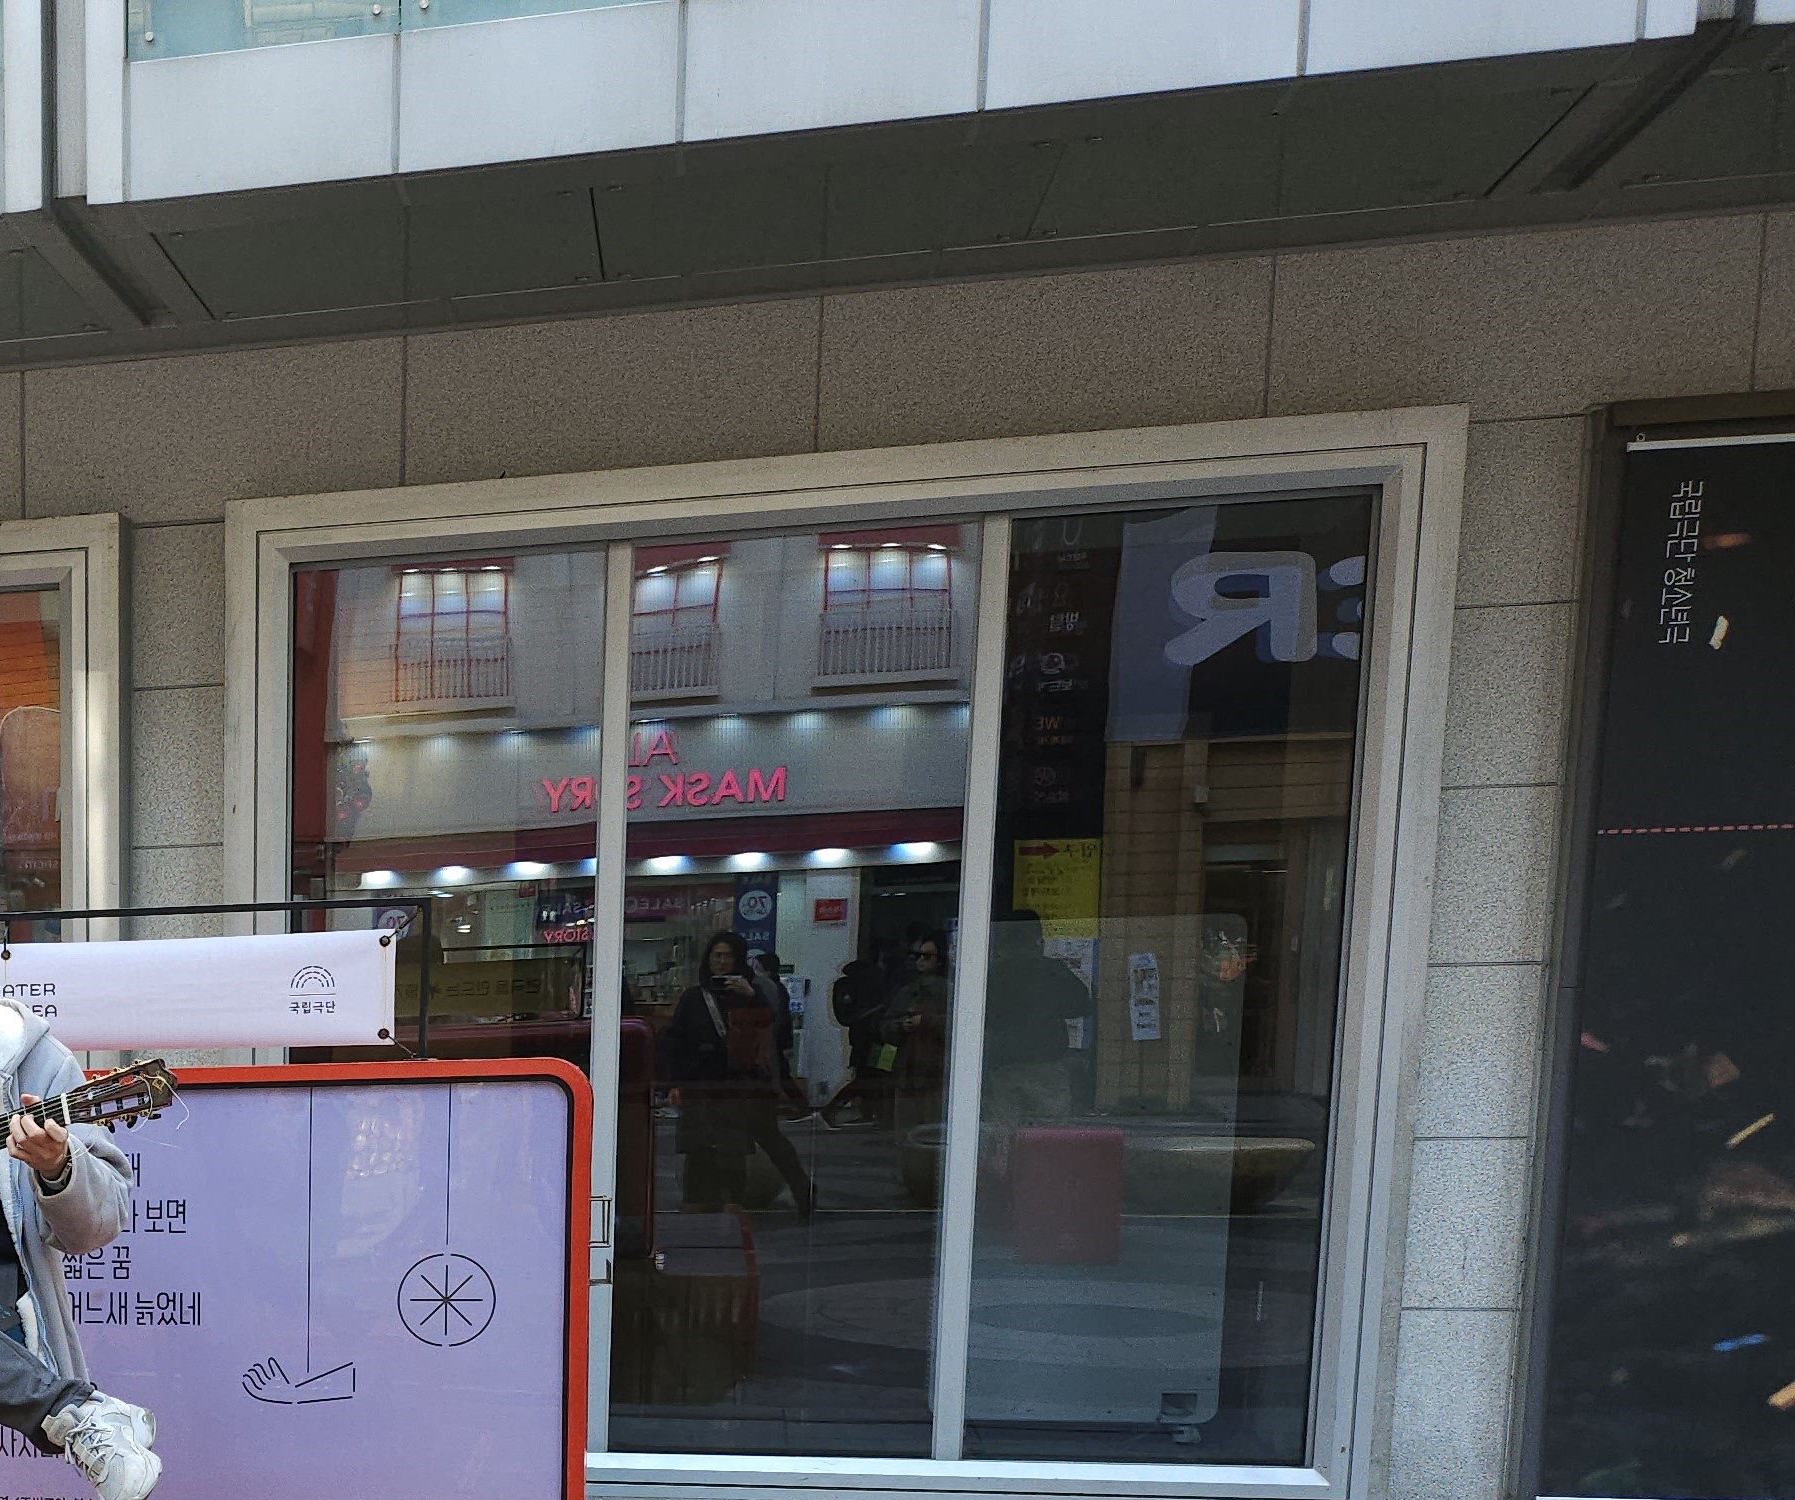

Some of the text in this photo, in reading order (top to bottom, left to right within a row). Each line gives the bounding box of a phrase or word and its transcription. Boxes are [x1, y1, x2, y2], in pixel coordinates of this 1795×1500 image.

[1658, 480, 1704, 644] 국립극단 청소년극
[288, 1001, 336, 1014] 국립극단
[144, 1199, 187, 1234] 보면
[62, 1246, 132, 1280] 짧은 꿈
[68, 1291, 201, 1326] 어느새 늙었네
